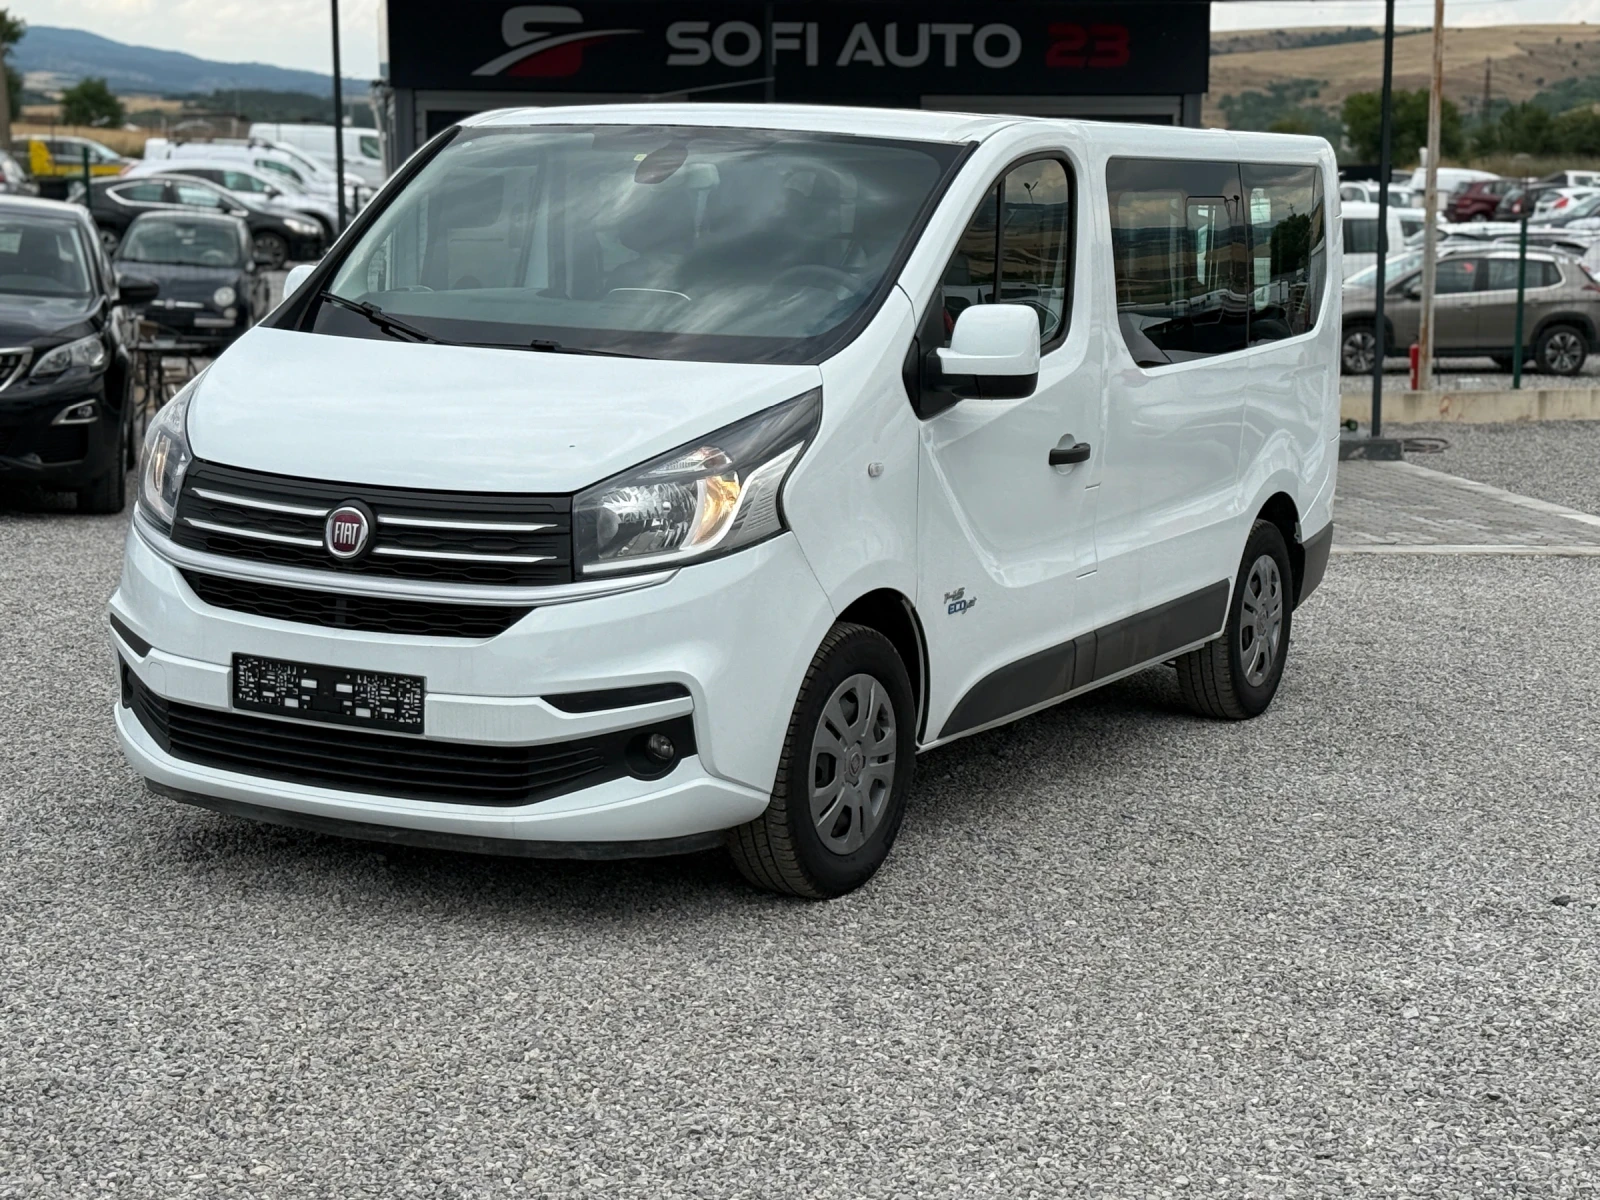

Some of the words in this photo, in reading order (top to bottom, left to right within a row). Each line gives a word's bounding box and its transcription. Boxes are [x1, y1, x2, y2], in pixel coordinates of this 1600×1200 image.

[666, 21, 818, 67] SOFI
[836, 23, 1023, 68] AUTO
[1045, 24, 1130, 68] 23
[333, 521, 360, 545] FIAT
